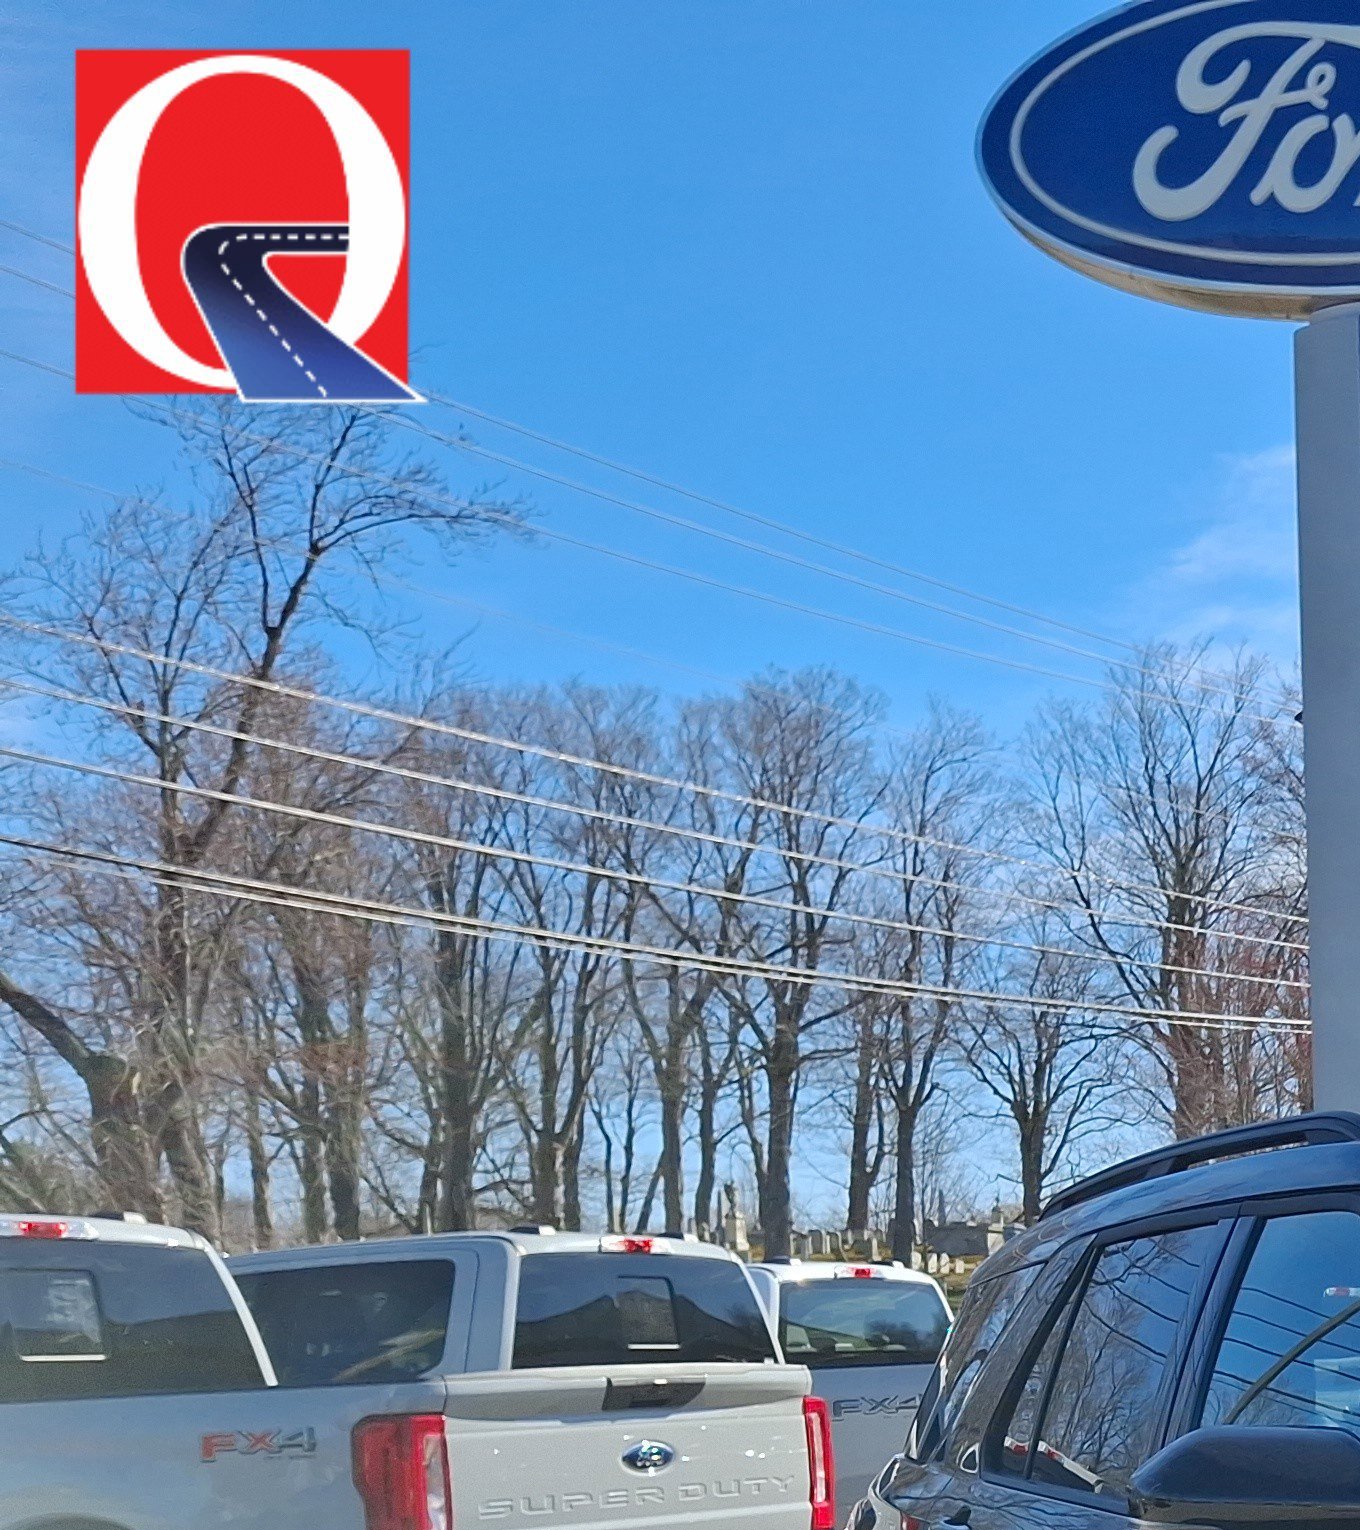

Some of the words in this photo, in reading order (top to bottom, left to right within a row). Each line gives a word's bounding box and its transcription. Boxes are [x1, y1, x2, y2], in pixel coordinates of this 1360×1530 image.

[200, 1426, 317, 1463] FX4
[476, 1484, 666, 1521] SUPER
[677, 1474, 796, 1502] DUTY
